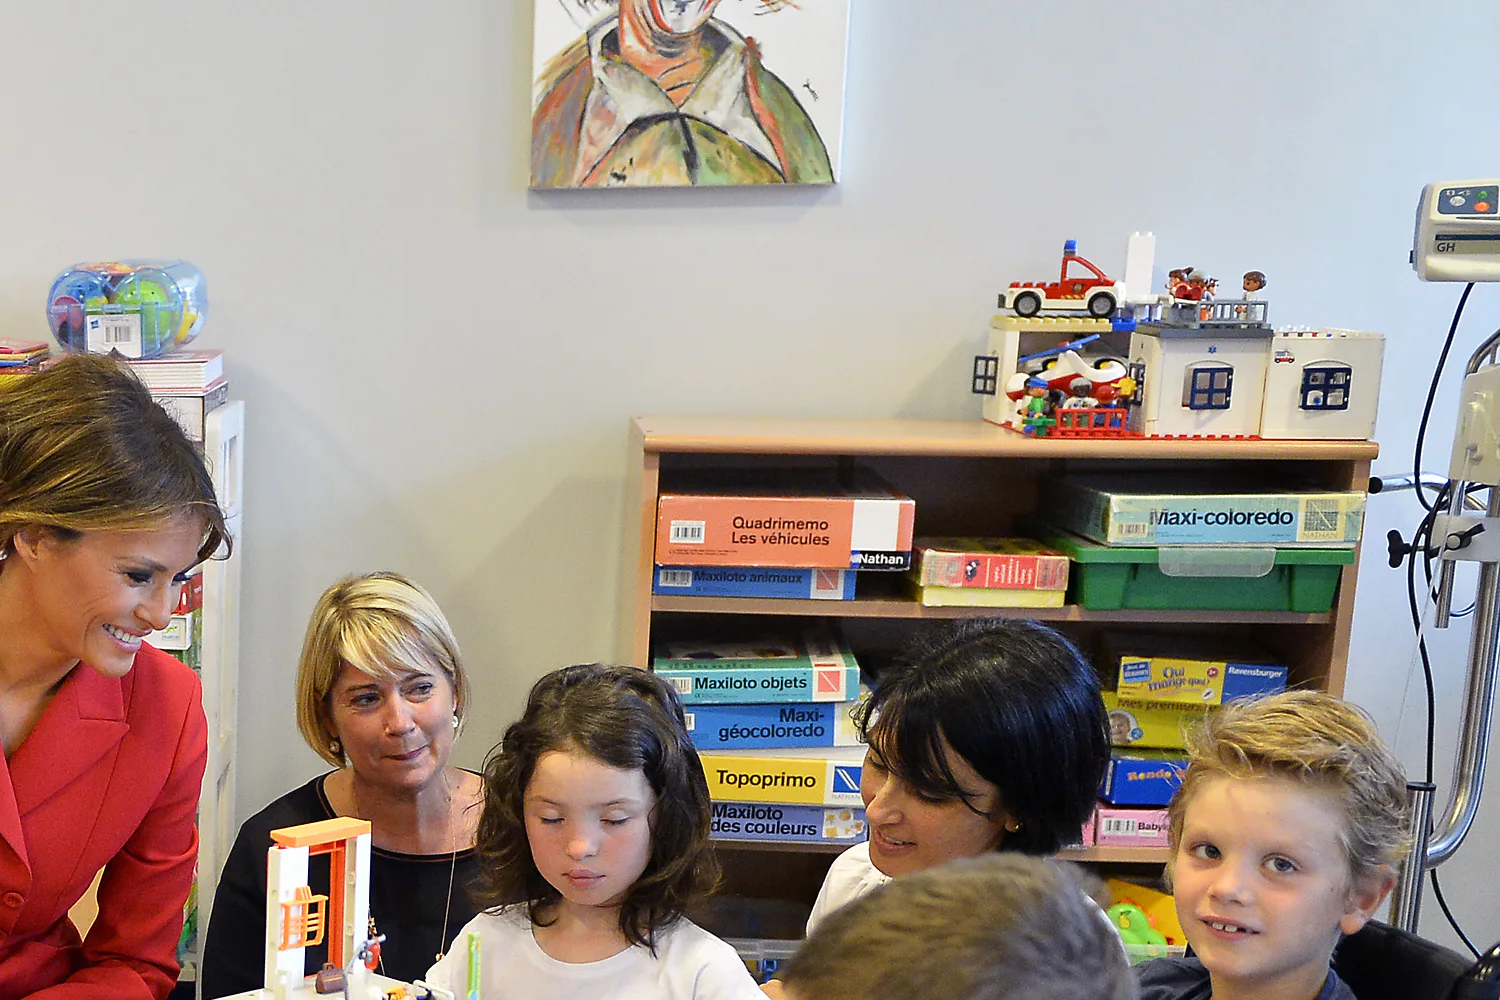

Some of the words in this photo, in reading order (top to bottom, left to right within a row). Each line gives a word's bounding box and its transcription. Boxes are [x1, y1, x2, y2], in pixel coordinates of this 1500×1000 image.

[1437, 242, 1456, 252] GH
[732, 516, 829, 531] Quadrimemo
[1149, 508, 1294, 525] Maxi-coloredo
[731, 531, 757, 544] Les
[761, 532, 830, 546] véhicules
[858, 552, 904, 565] Nathan
[694, 570, 747, 582] Maxiloto
[749, 571, 803, 583] animaux
[1228, 666, 1283, 678] Ravensburger
[694, 677, 758, 689] Maxiloto
[761, 677, 807, 691] objets
[779, 708, 825, 723] Maxi-
[718, 723, 825, 742] géocoloredo
[716, 770, 817, 789] Topoprimo
[712, 805, 783, 820] Maxiloto
[711, 819, 740, 833] des
[745, 821, 817, 836] couleurs
